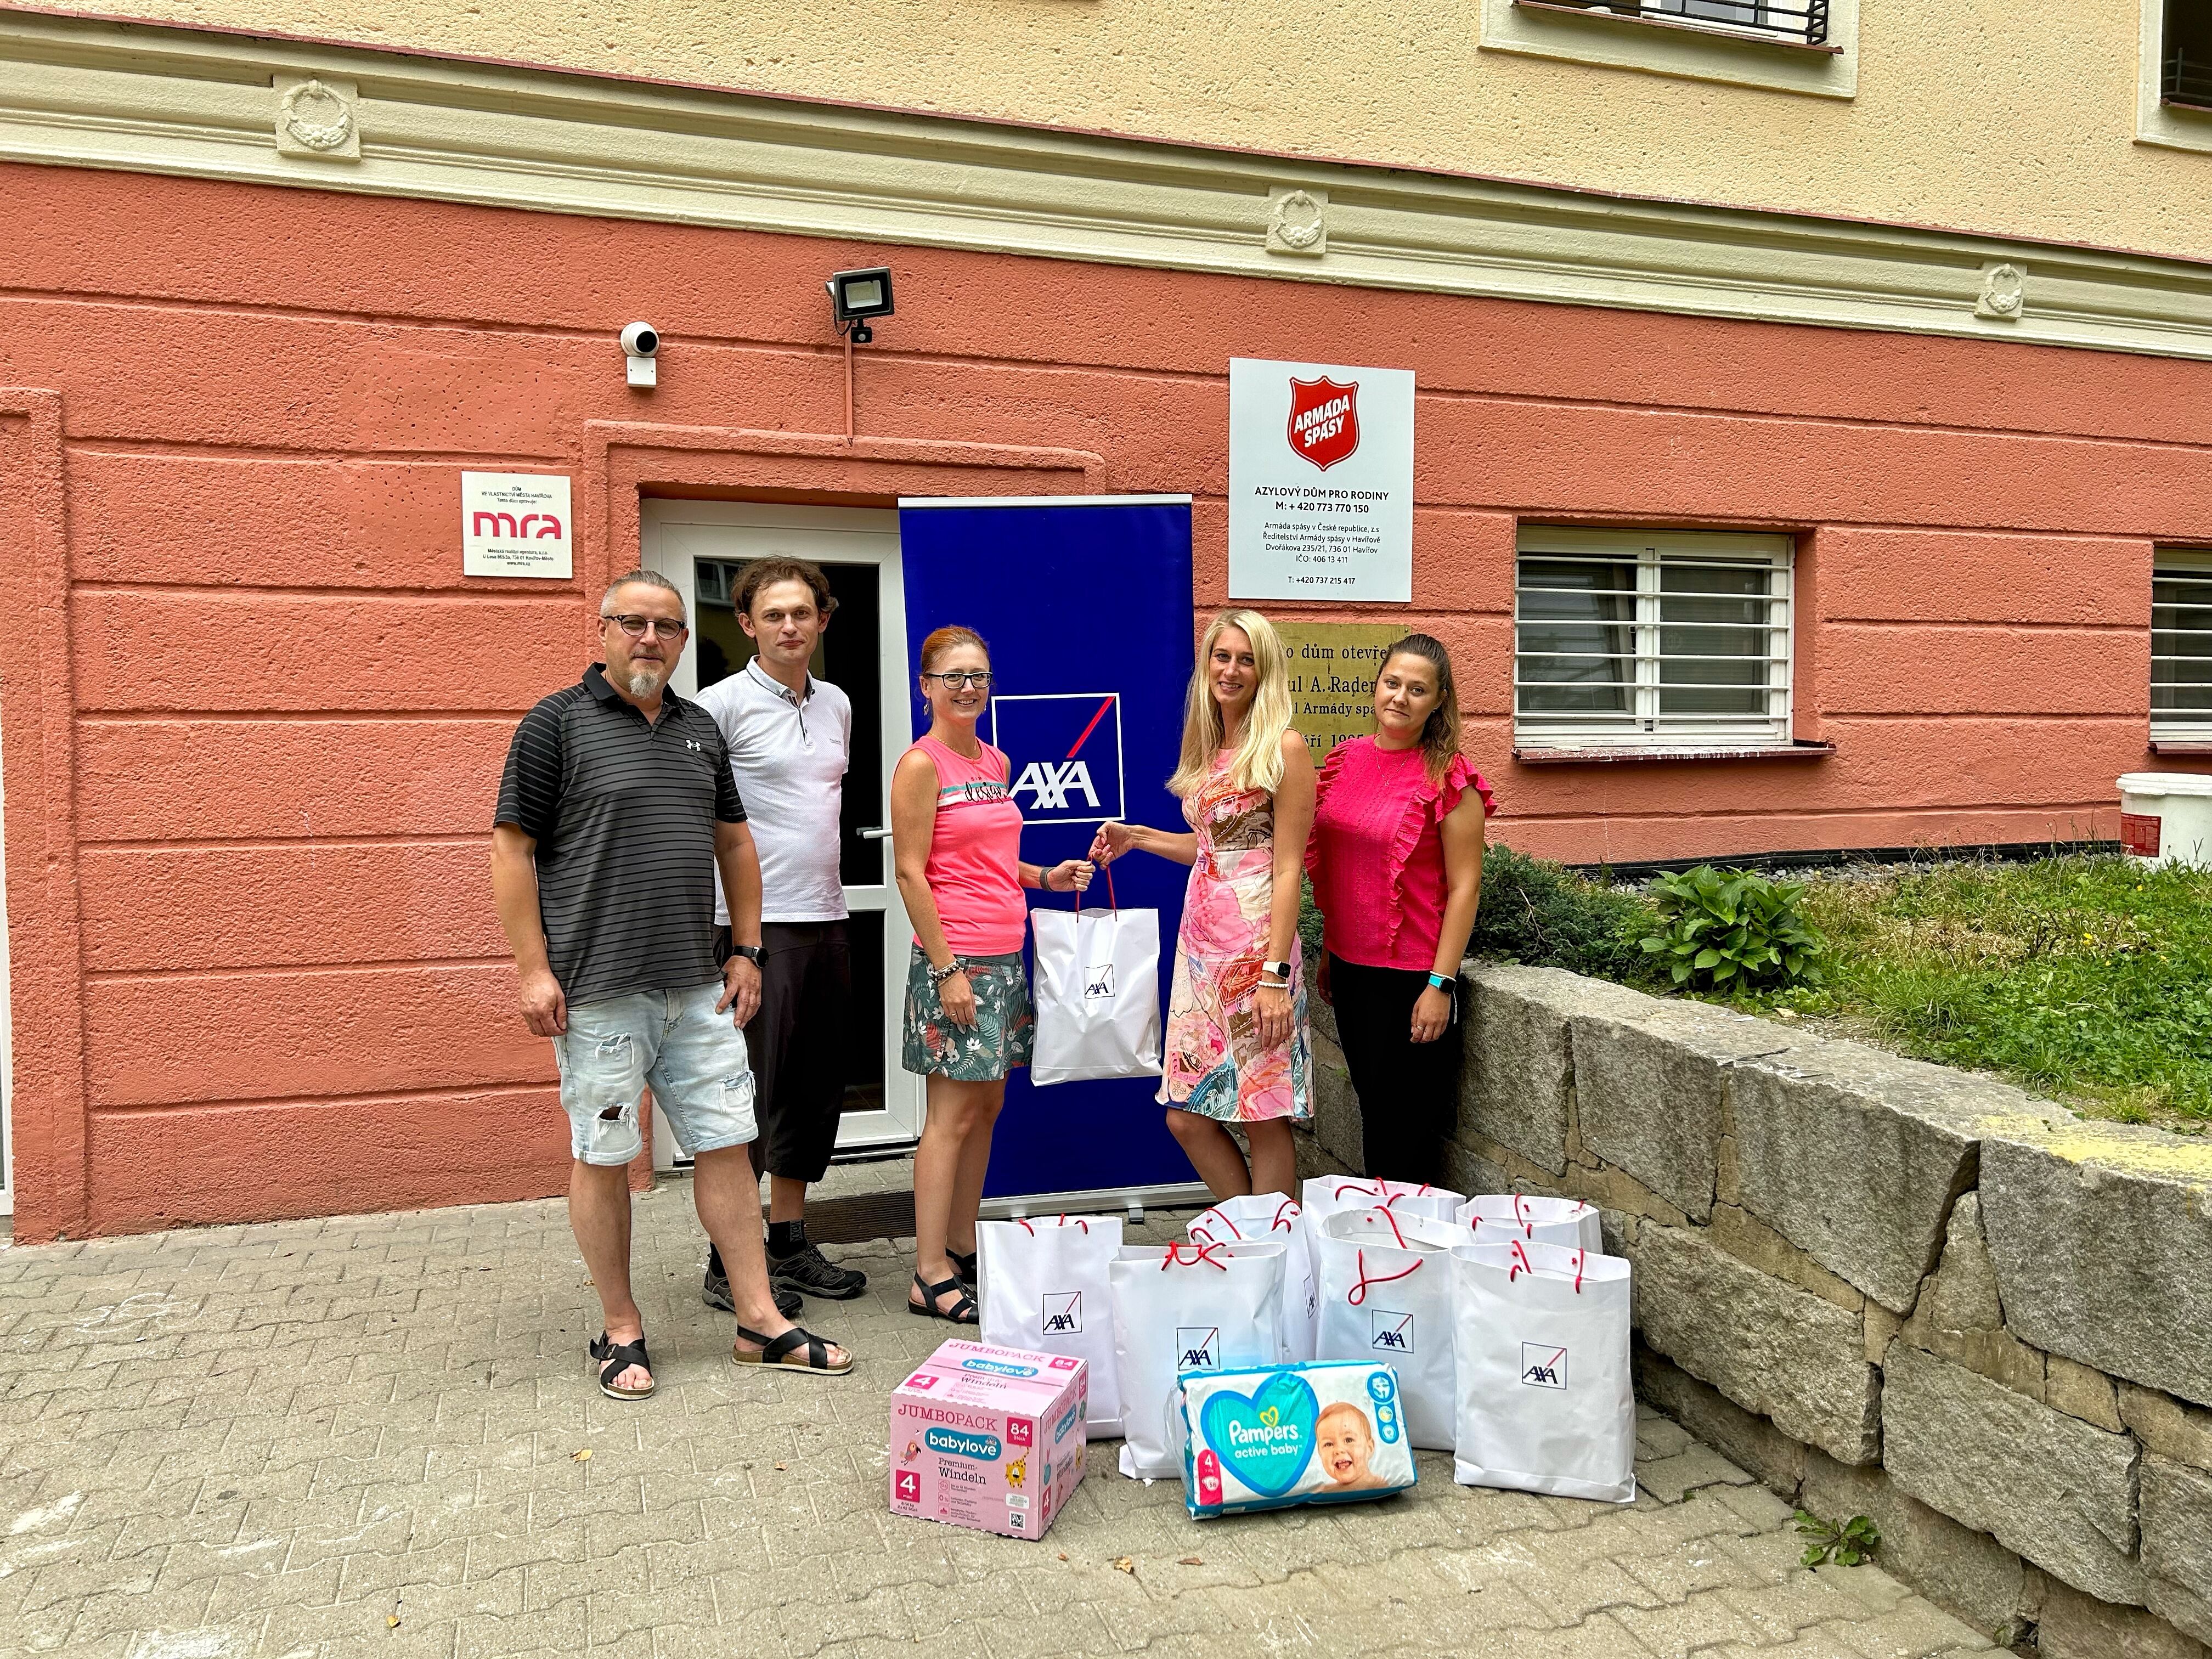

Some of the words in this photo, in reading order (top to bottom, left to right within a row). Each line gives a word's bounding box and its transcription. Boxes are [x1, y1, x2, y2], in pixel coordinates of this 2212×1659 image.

[1294, 394, 1350, 434] ARMÁDA
[1304, 414, 1345, 448] SPÁSY
[1255, 486, 1301, 496] AZYLOVÝ
[1304, 487, 1326, 498] DŮM
[1329, 490, 1348, 499] PRO
[1351, 491, 1389, 500] RODINY
[1276, 501, 1287, 510] M:
[1297, 503, 1314, 511] 420
[1317, 503, 1333, 512] 773
[1335, 504, 1351, 512] 770
[1353, 504, 1369, 513] 150
[473, 511, 562, 540] mra
[1292, 523, 1311, 532] spásy
[1317, 522, 1336, 532] České
[1338, 524, 1370, 533] republice,
[1263, 531, 1298, 540] Ředitelství
[1300, 534, 1326, 543] Armády
[1327, 535, 1345, 544] spásy
[1302, 544, 1327, 553] 235/21,
[1296, 554, 1311, 562] IČO:
[1301, 643, 1334, 659] dům
[1342, 645, 1389, 659] otevře
[1303, 702, 1352, 718] Armády
[1356, 703, 1375, 718] spá
[1007, 761, 1101, 809] AXA
[1085, 981, 1109, 995] AXA
[1044, 1313, 1075, 1330] AXA
[1373, 1331, 1406, 1347] AXA
[949, 1342, 1046, 1362] JUMBOPACK
[1180, 1349, 1212, 1365] AXA
[966, 1360, 1032, 1376] babylove
[1523, 1365, 1558, 1384] AXA
[914, 1376, 932, 1386] 4
[898, 1403, 998, 1432] JUMBOPACK
[1044, 1385, 1077, 1434] JUMBOPACK
[1011, 1423, 1029, 1437] 84
[1229, 1420, 1299, 1446] Pampers
[930, 1432, 997, 1456] babylove
[1234, 1446, 1268, 1459] active
[1271, 1443, 1299, 1457] baby
[1204, 1454, 1212, 1468] 4
[900, 1474, 916, 1493] 4
[938, 1466, 986, 1485] Windeln
[1044, 1490, 1049, 1507] 4
